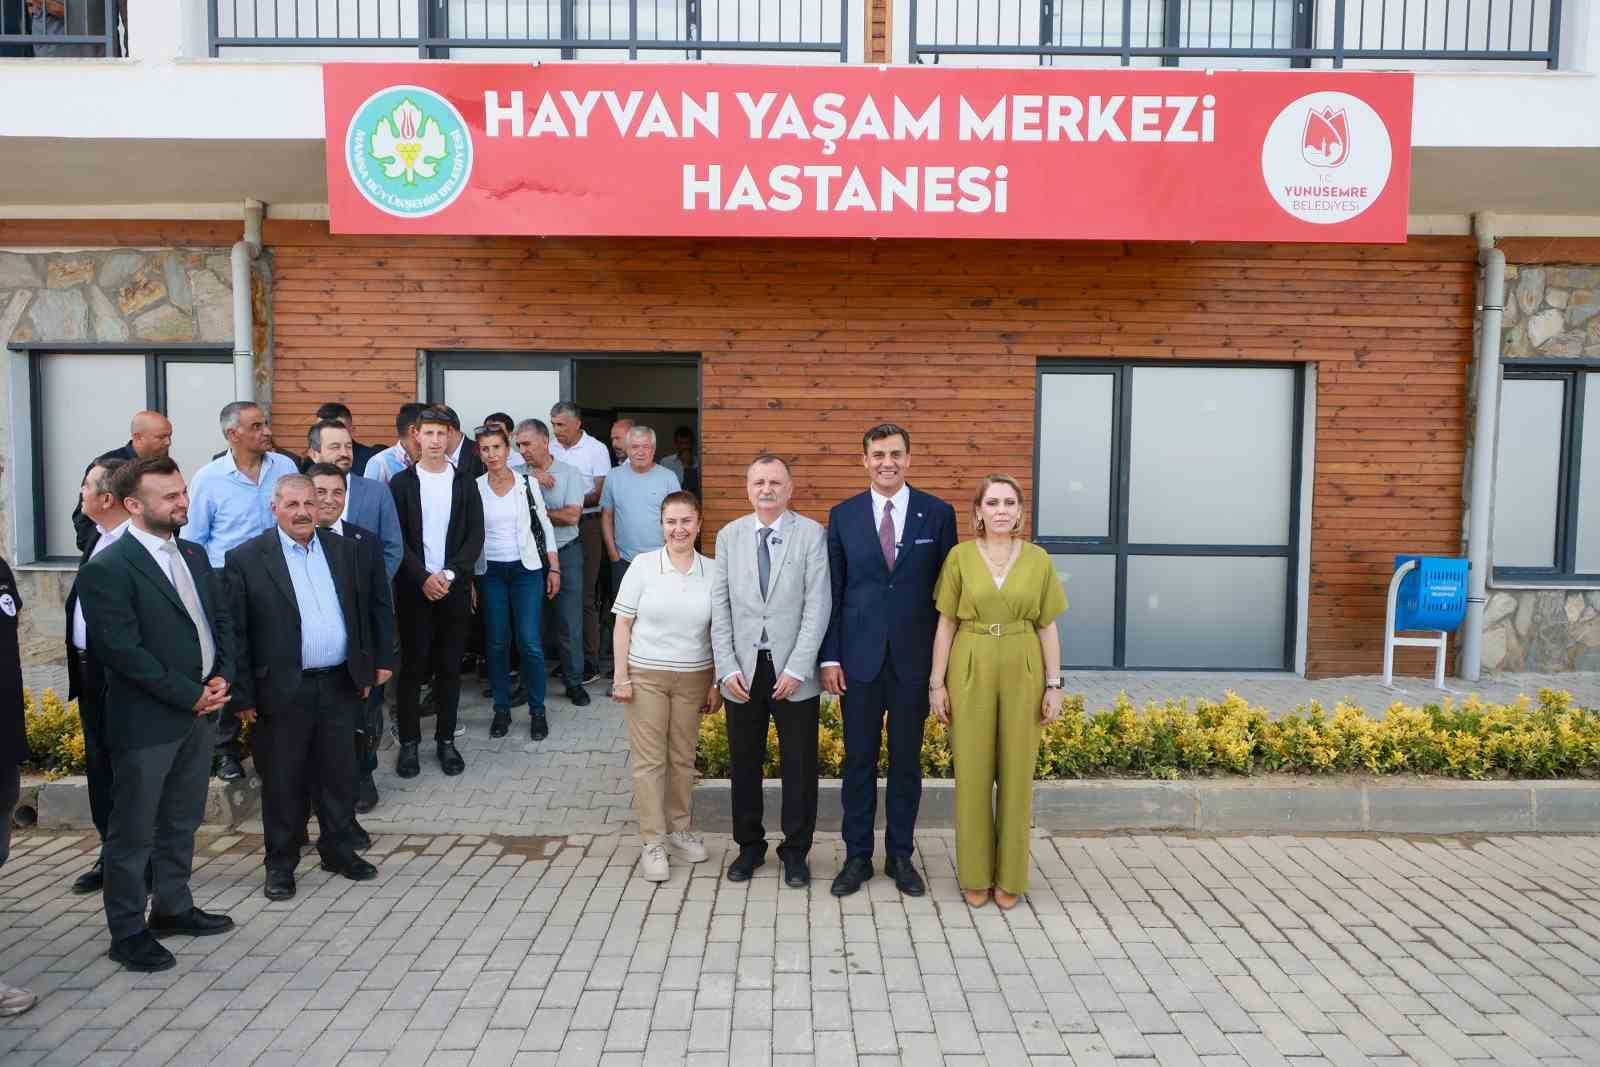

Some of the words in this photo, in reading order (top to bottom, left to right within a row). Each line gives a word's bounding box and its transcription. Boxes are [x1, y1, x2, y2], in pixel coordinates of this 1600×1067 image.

[484, 90, 720, 139] HAYVAN
[735, 92, 941, 155] YAŞAM
[1284, 185, 1369, 198] YUNUSEMRE
